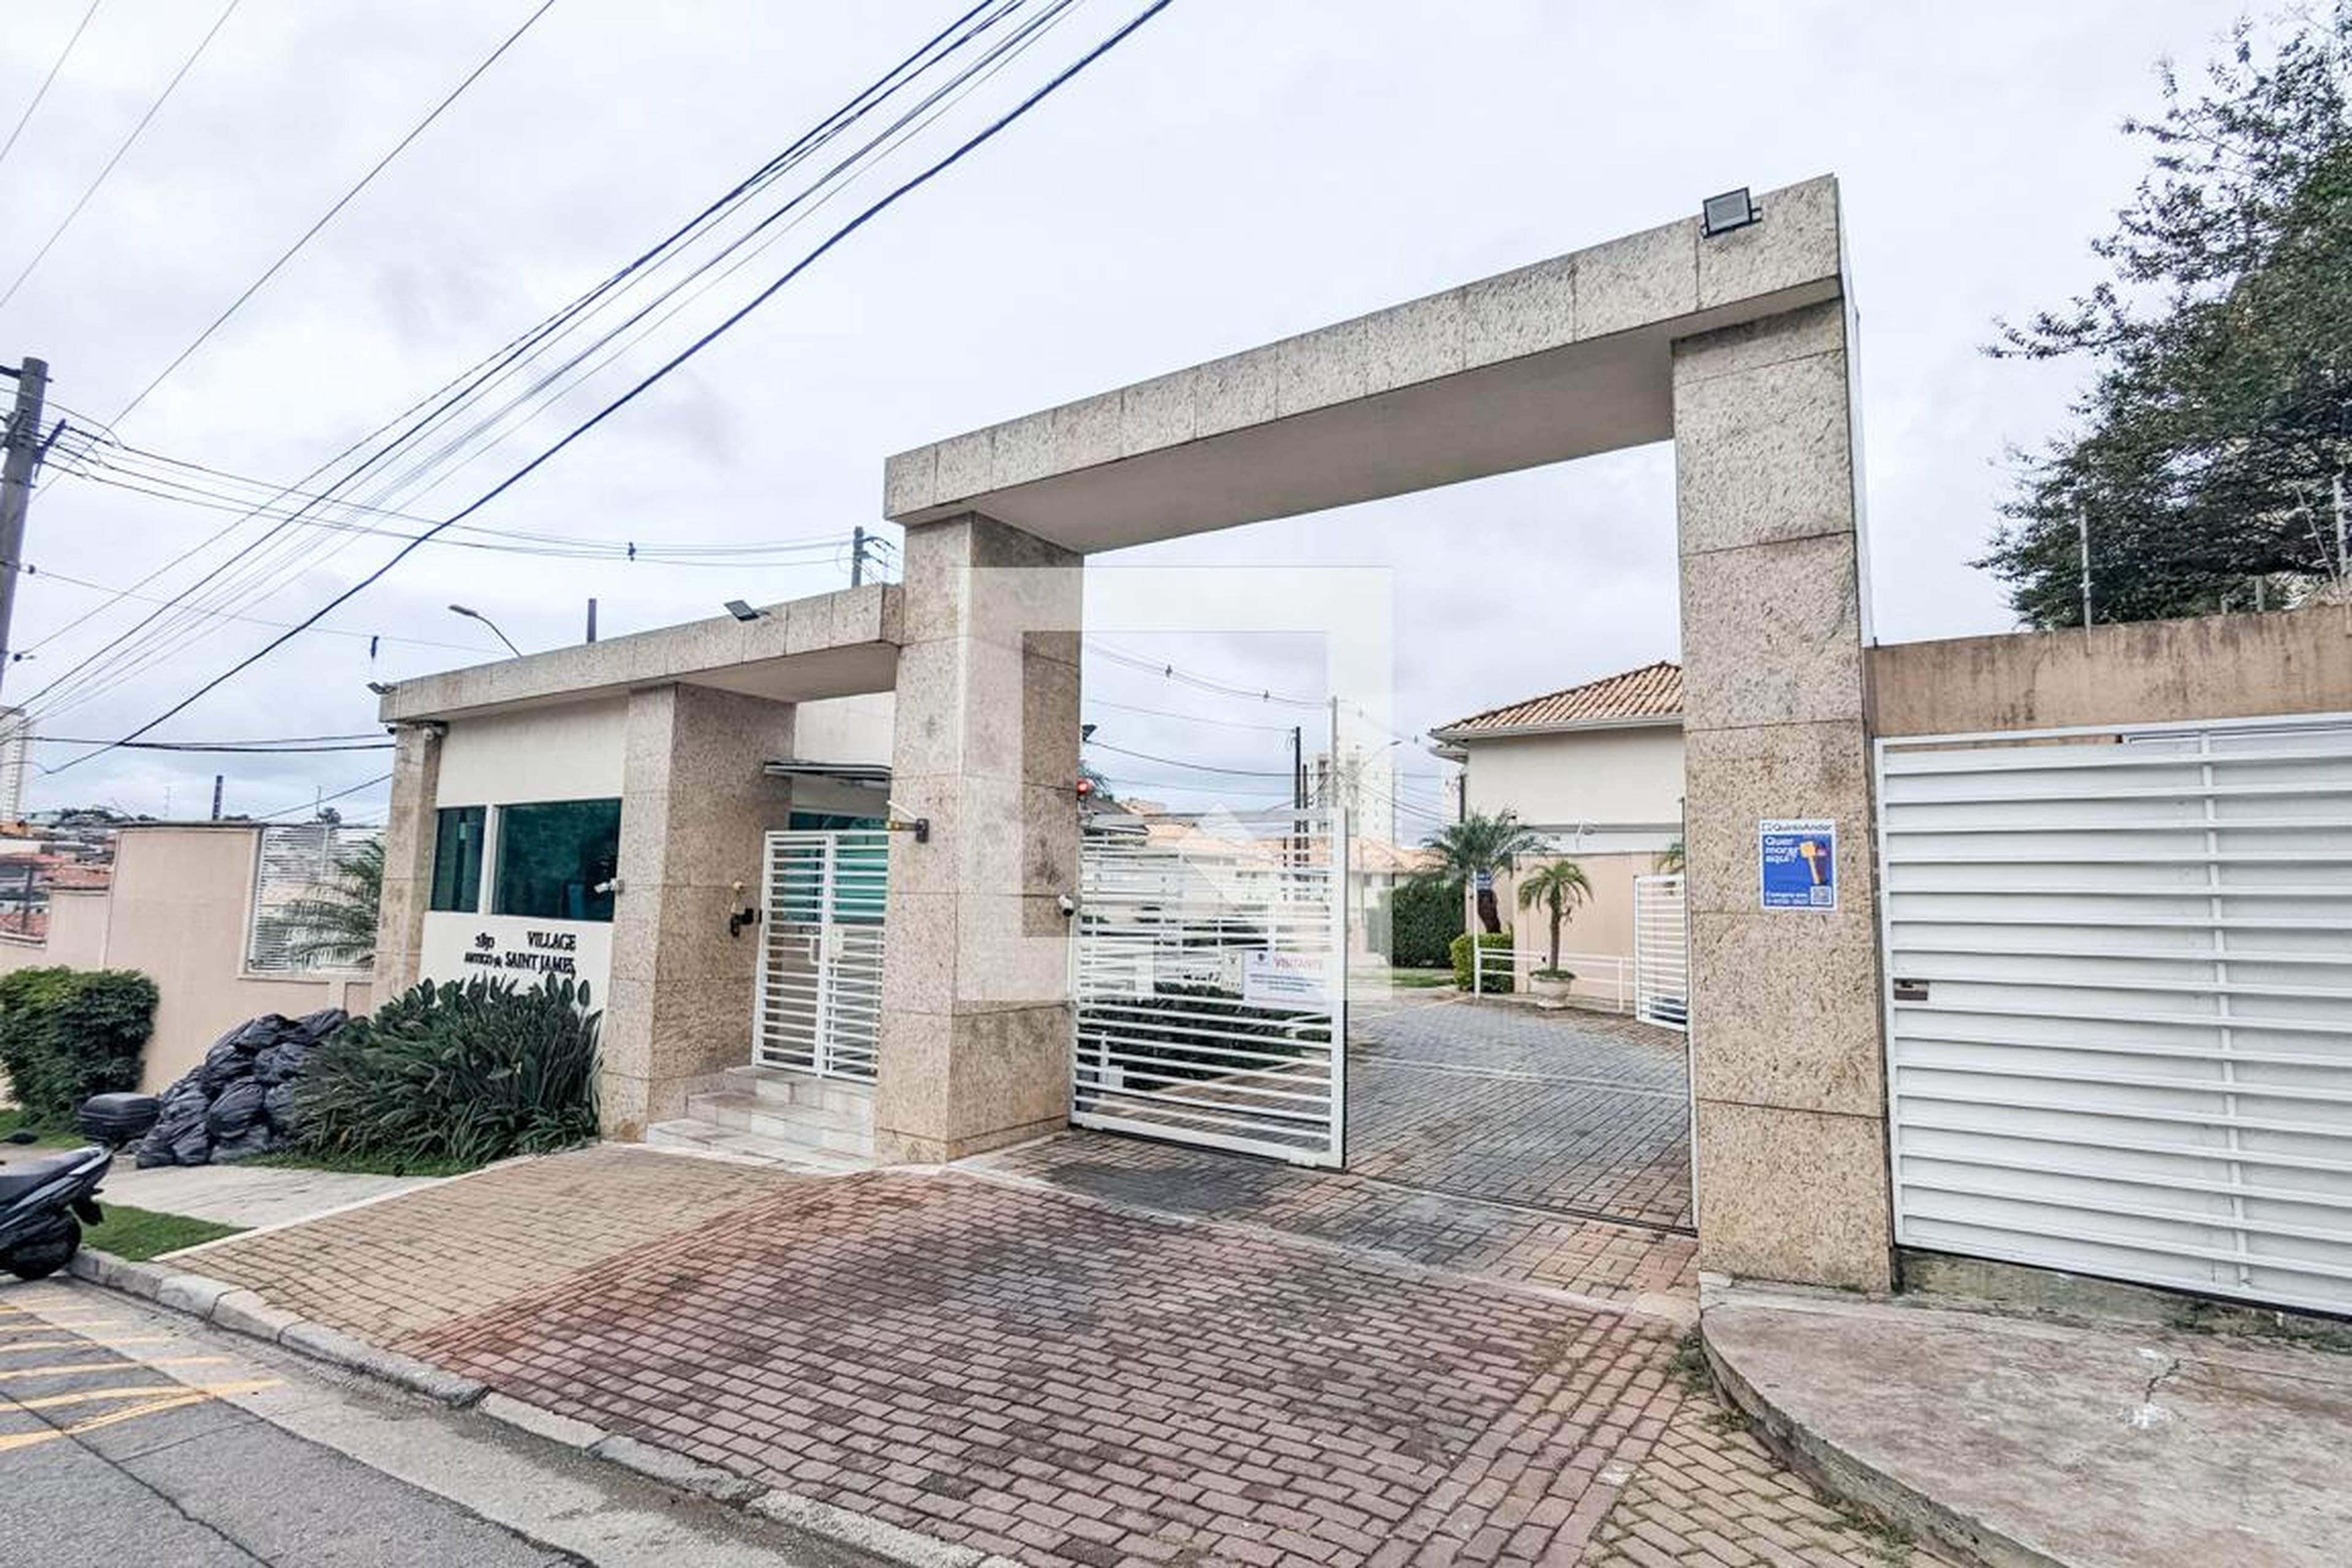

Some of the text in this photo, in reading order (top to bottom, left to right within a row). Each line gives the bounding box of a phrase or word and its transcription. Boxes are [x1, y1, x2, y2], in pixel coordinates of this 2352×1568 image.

[527, 931, 576, 951] VILLAGE
[505, 951, 539, 970] SAINT
[538, 954, 576, 980] JAMES
